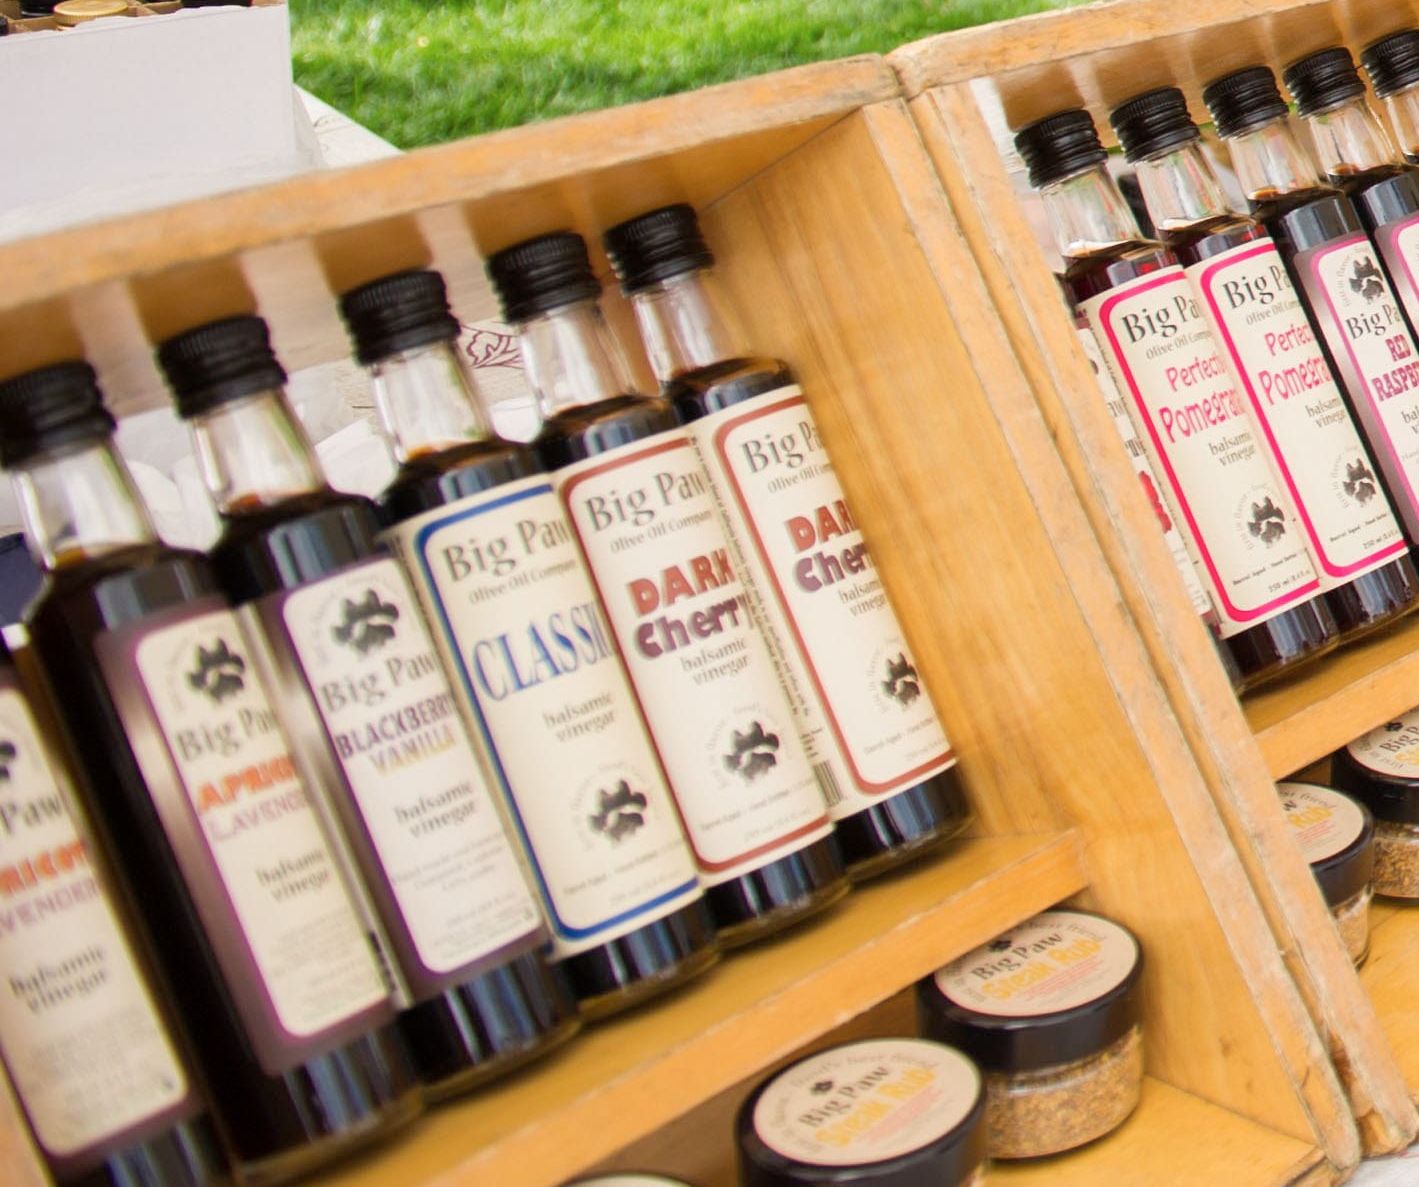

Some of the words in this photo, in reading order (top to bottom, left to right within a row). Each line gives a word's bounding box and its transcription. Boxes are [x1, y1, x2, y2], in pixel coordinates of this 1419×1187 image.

[1222, 275, 1275, 310] Big
[1121, 308, 1178, 344] Big
[1245, 309, 1272, 326] Olive
[1346, 313, 1387, 340] Big
[1145, 341, 1174, 360] Olive
[1386, 334, 1412, 362] RED
[741, 433, 804, 475] Big
[767, 474, 800, 494] Olive
[584, 488, 656, 533] Big
[609, 531, 647, 555] Olive
[646, 521, 668, 541] Oil
[442, 537, 517, 582] Big
[469, 581, 507, 605] Olive
[508, 571, 529, 591] Oil
[626, 546, 737, 618] DARK
[680, 635, 748, 672] balsamic
[693, 653, 750, 686] vinegar
[321, 673, 387, 716] Big
[543, 692, 614, 728] balsamic
[176, 721, 240, 761] Big
[555, 708, 616, 743] vinegar
[370, 723, 457, 777] VANILLA
[394, 780, 473, 825] balsamic
[408, 799, 478, 839] vinegar
[971, 957, 1022, 981] Big
[1012, 932, 1064, 960] Paw
[798, 1095, 856, 1132] Big
[840, 1064, 891, 1103] Paw
